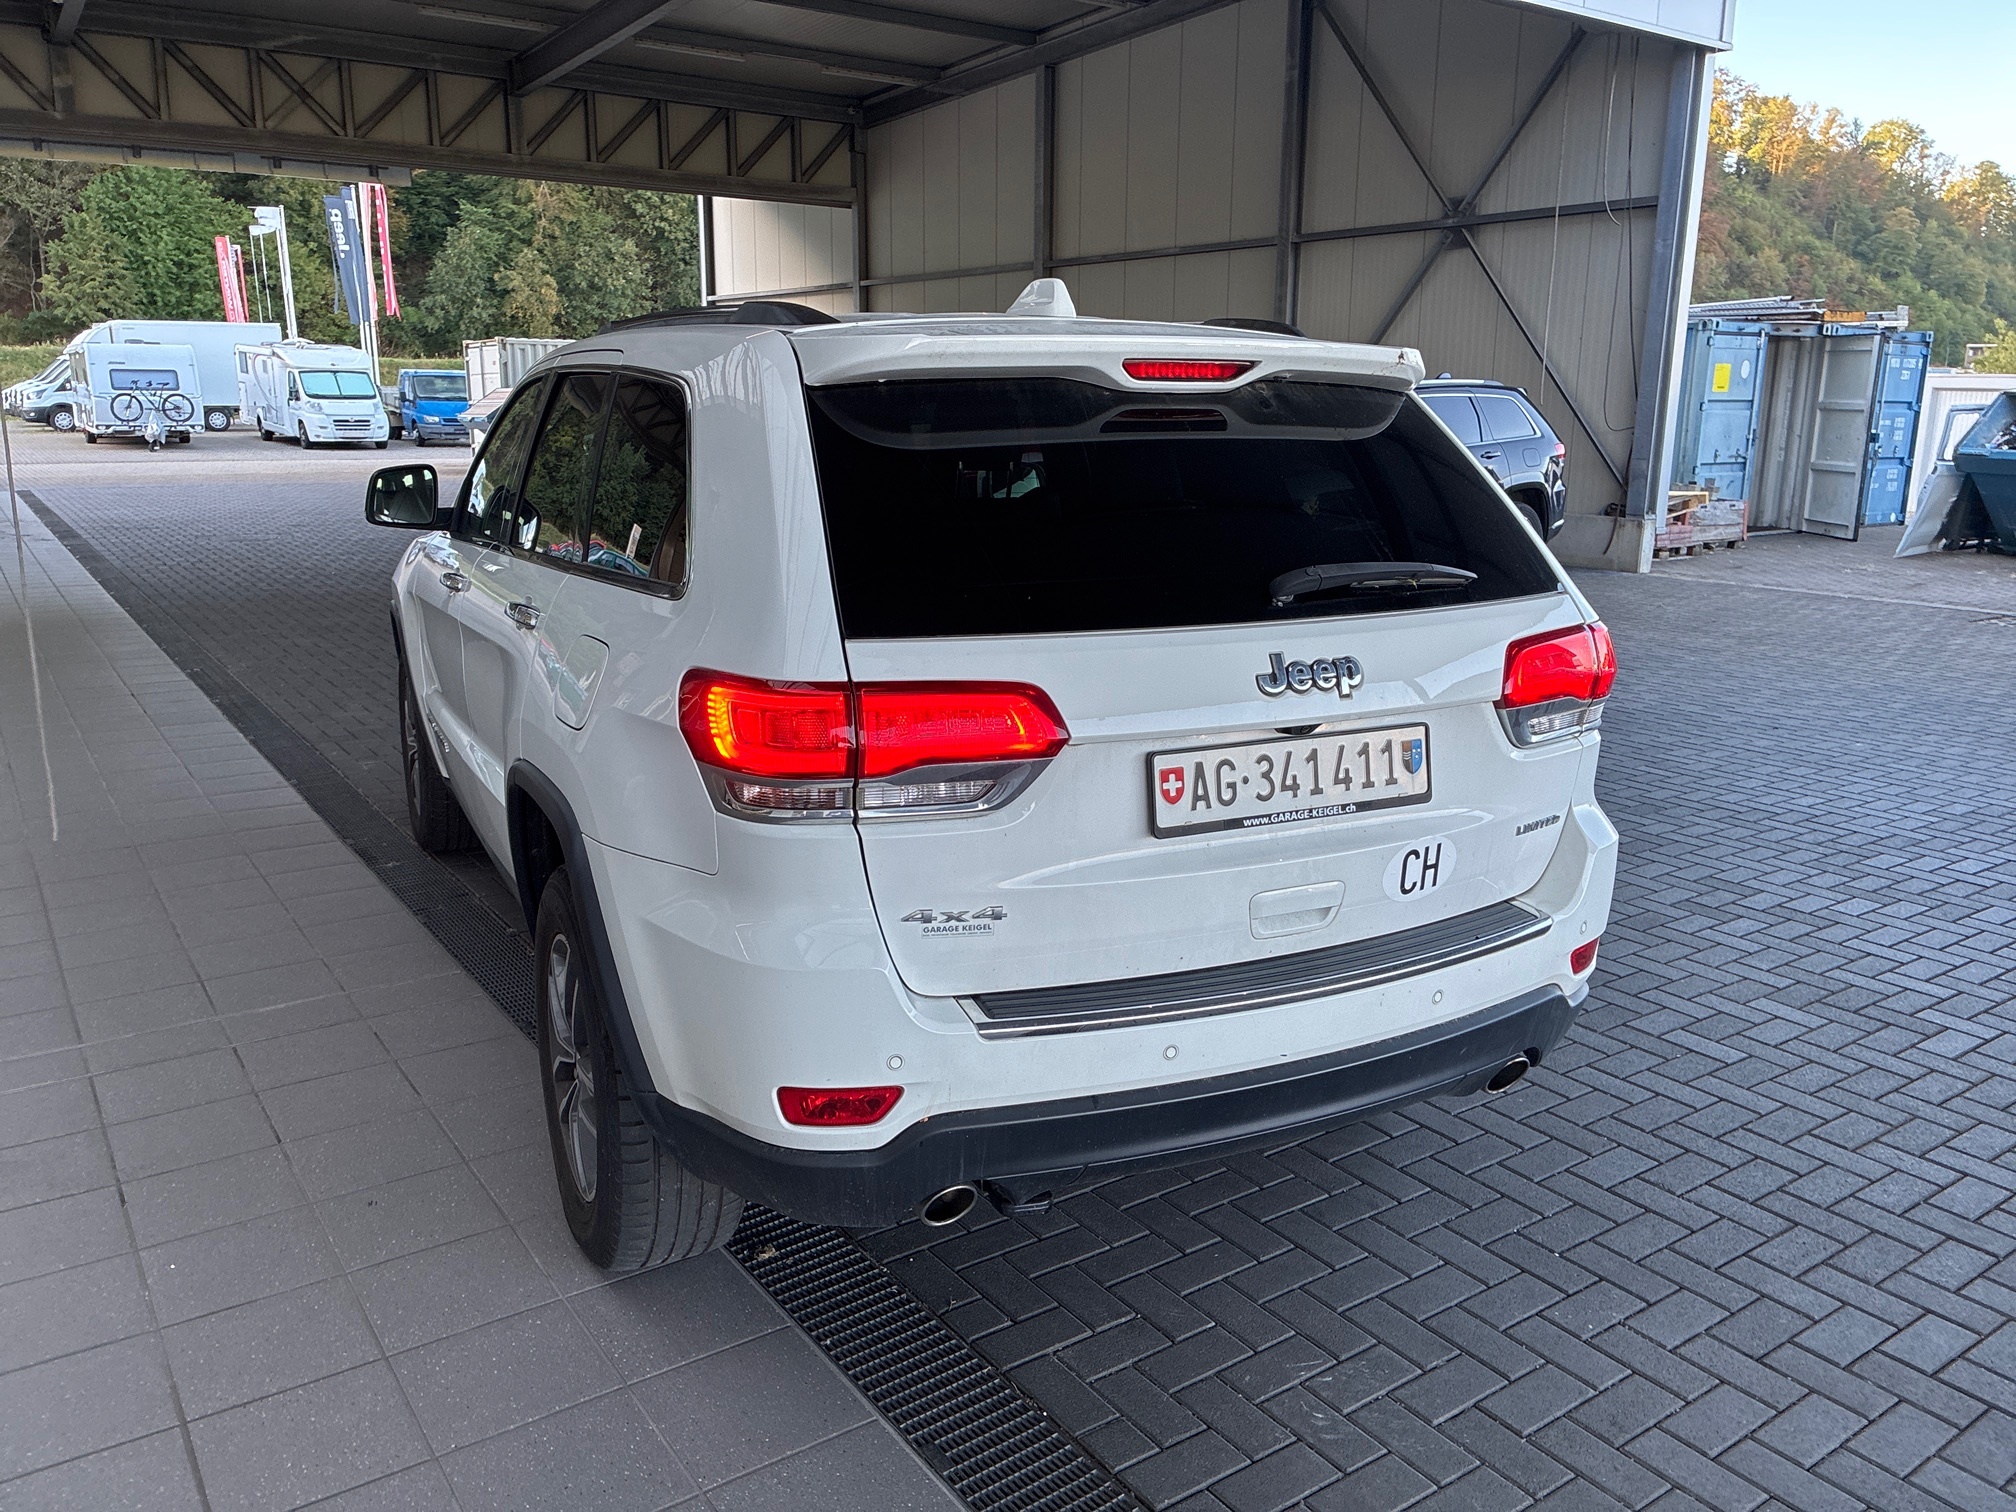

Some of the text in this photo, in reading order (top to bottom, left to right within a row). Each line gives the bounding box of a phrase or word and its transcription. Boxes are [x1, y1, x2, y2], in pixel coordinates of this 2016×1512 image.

[1256, 652, 1363, 699] Jeep
[1243, 804, 1357, 828] www.GARAGE-KEIGEL.ch
[1515, 814, 1561, 837] LIMITED
[1400, 843, 1442, 895] CH
[901, 905, 1008, 924] 4x4
[922, 925, 960, 934] GARAGE
[961, 923, 993, 932] KEIGEL
